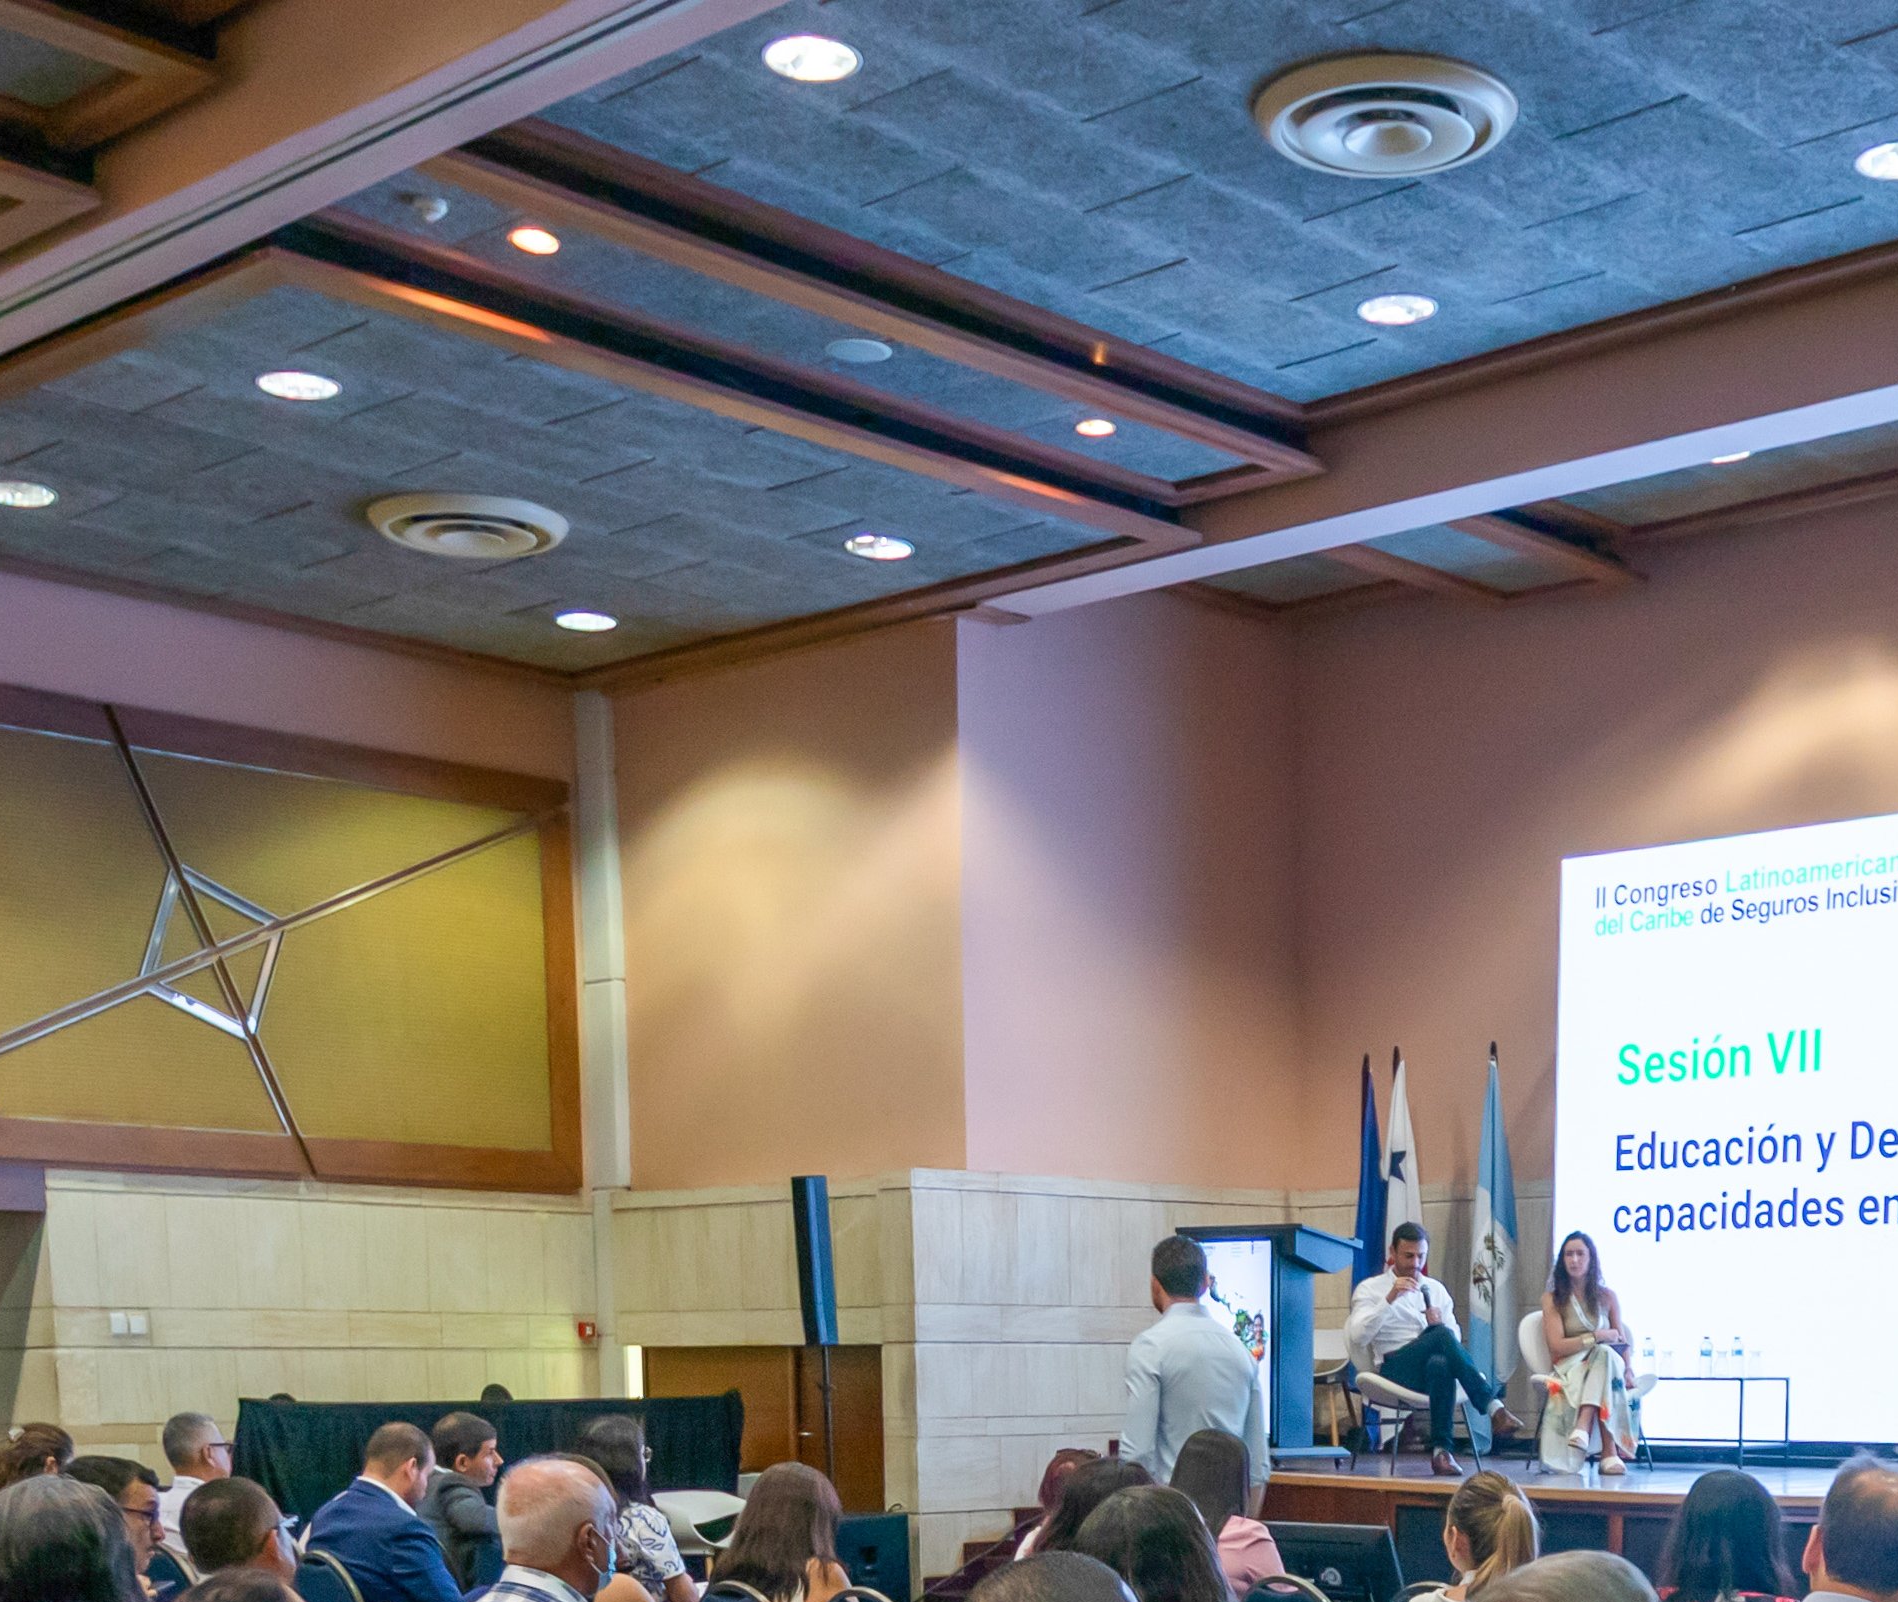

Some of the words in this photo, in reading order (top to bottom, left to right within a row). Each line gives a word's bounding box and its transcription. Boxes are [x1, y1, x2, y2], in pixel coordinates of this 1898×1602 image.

[1594, 912, 1624, 936] del
[1629, 907, 1694, 932] Caribe
[1700, 902, 1725, 924] de
[1730, 894, 1820, 924] Seguros
[1595, 886, 1607, 909] II
[1613, 878, 1718, 908] Congreso
[1617, 1033, 1752, 1086] Sesión
[1766, 1027, 1823, 1076] VII
[1615, 1122, 1803, 1172] Educación
[1815, 1131, 1837, 1173] y
[1613, 1186, 1845, 1243] capacidades
